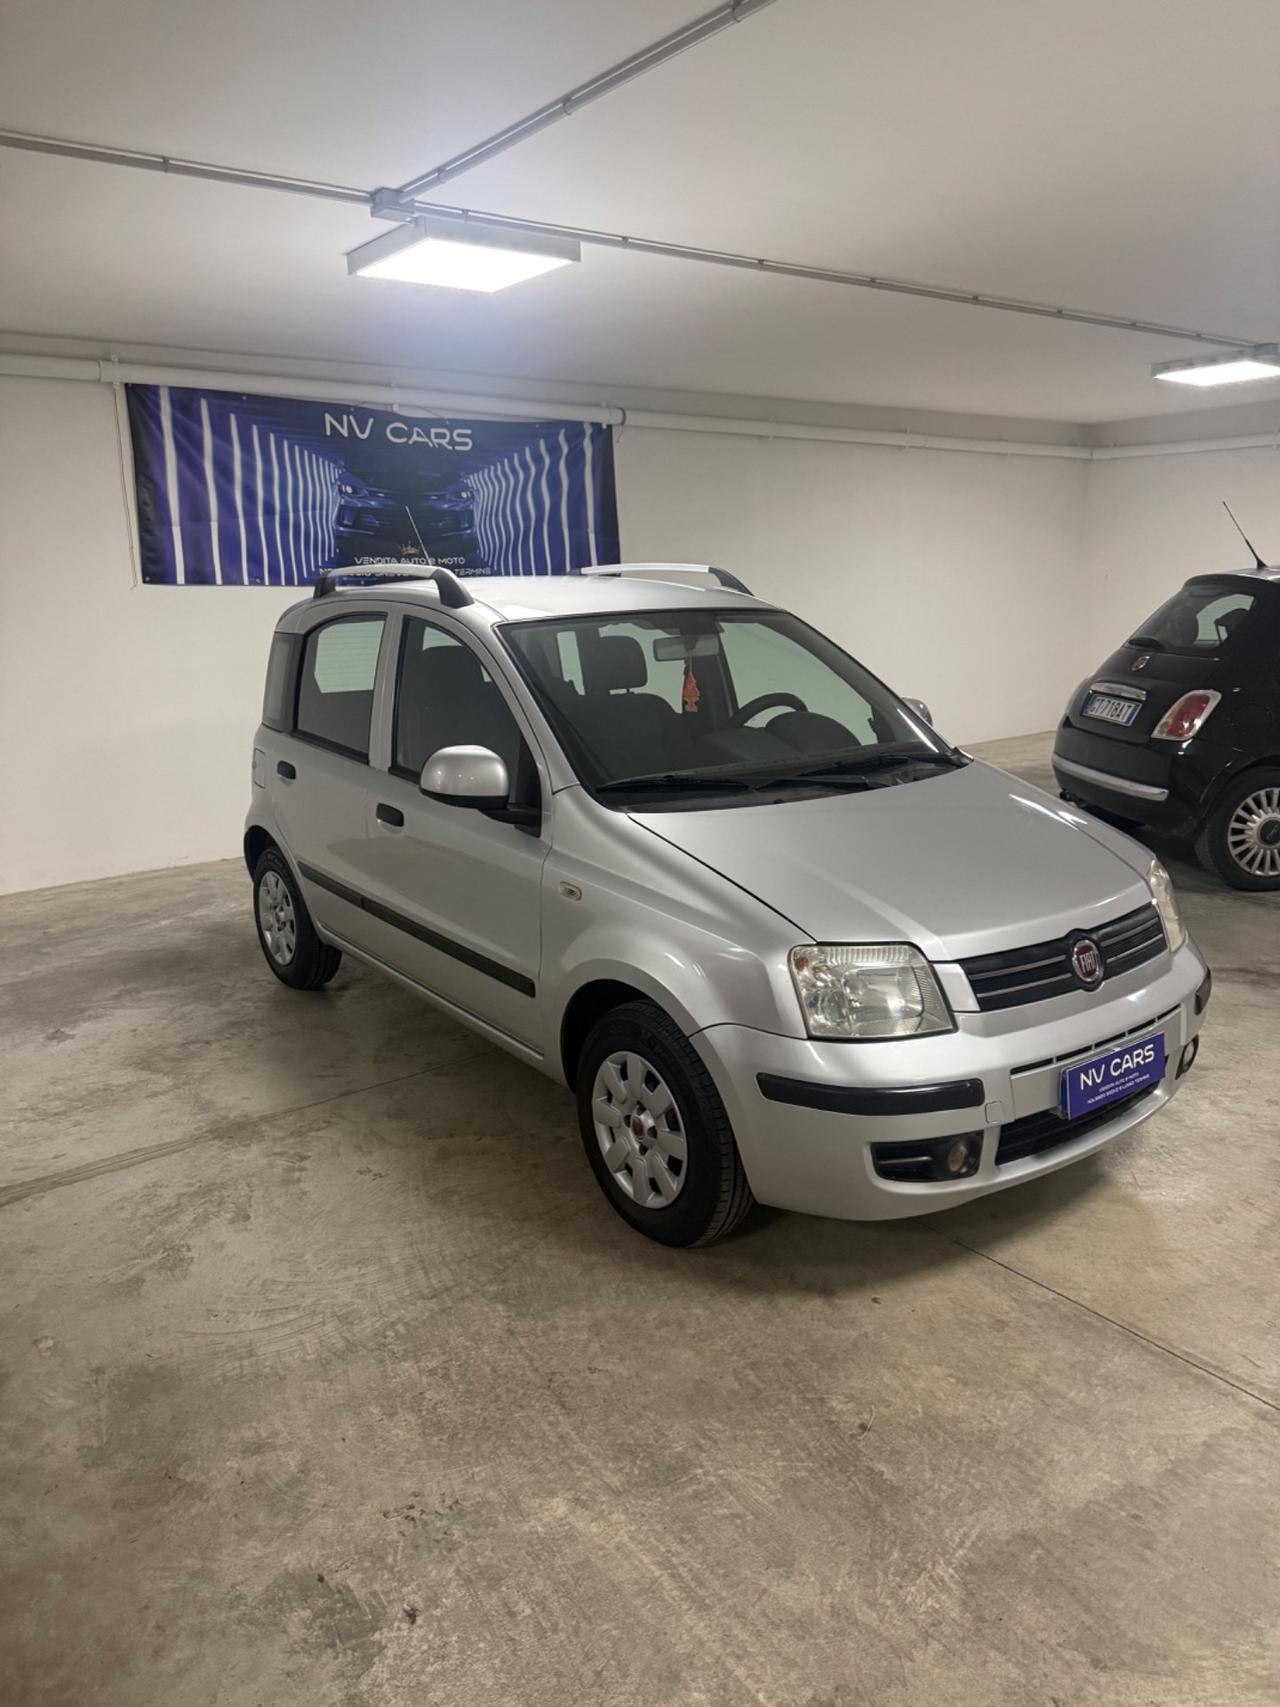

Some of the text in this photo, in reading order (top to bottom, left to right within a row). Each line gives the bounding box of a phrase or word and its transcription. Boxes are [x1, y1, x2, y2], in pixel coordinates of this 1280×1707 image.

[324, 413, 474, 451] NV CARS
[353, 556, 398, 565] VENDITA
[400, 556, 426, 565] AUTO
[438, 556, 466, 565] MOTO
[1080, 1064, 1105, 1090] NV
[1110, 1043, 1155, 1077] CARS
